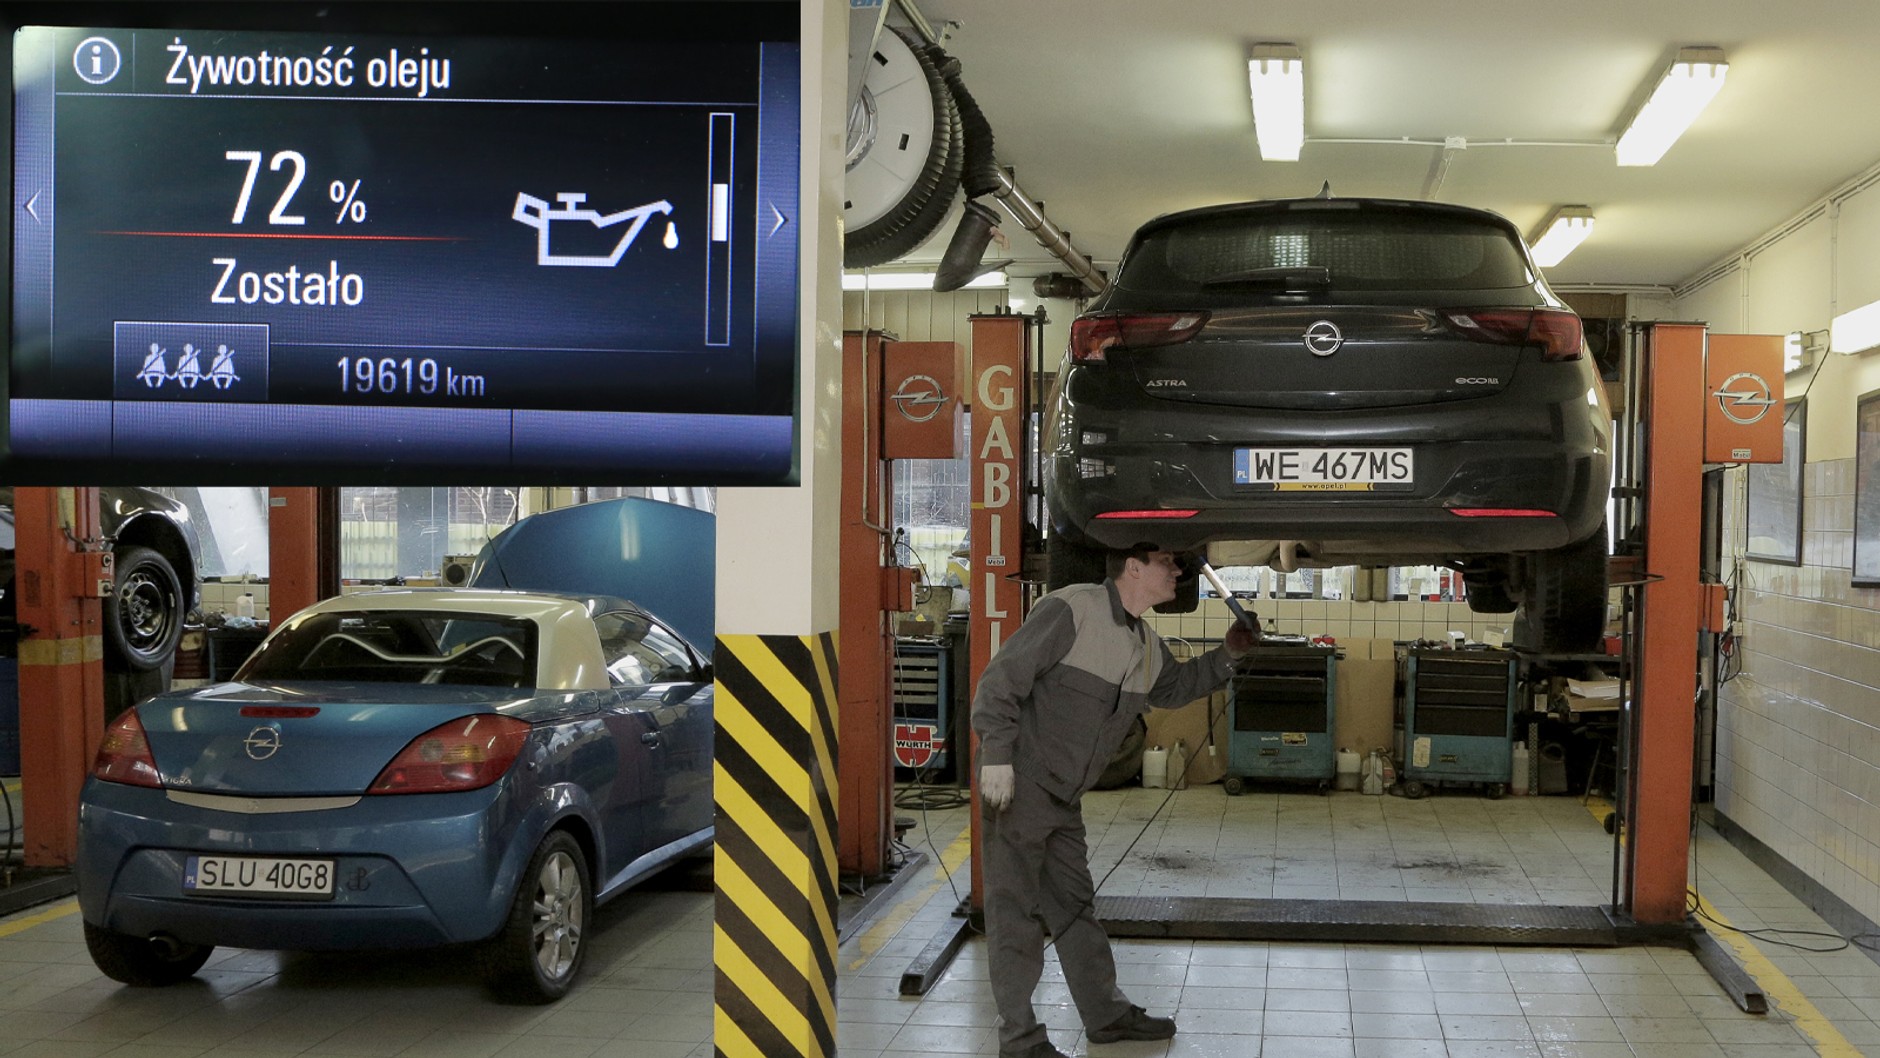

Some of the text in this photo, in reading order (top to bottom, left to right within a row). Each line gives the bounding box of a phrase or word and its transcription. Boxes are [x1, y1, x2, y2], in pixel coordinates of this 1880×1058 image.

[166, 37, 451, 97] Żywotność oleju
[225, 150, 367, 225] 72 %
[210, 258, 364, 307] Zostało
[337, 357, 486, 397] 19619 km
[1146, 379, 1187, 387] ASTRA
[1237, 470, 1248, 479] PL
[1255, 452, 1409, 480] WE 467MS
[1302, 482, 1347, 490] www.opel.pl
[186, 876, 196, 884] PL
[201, 860, 328, 890] SLU 40G8
